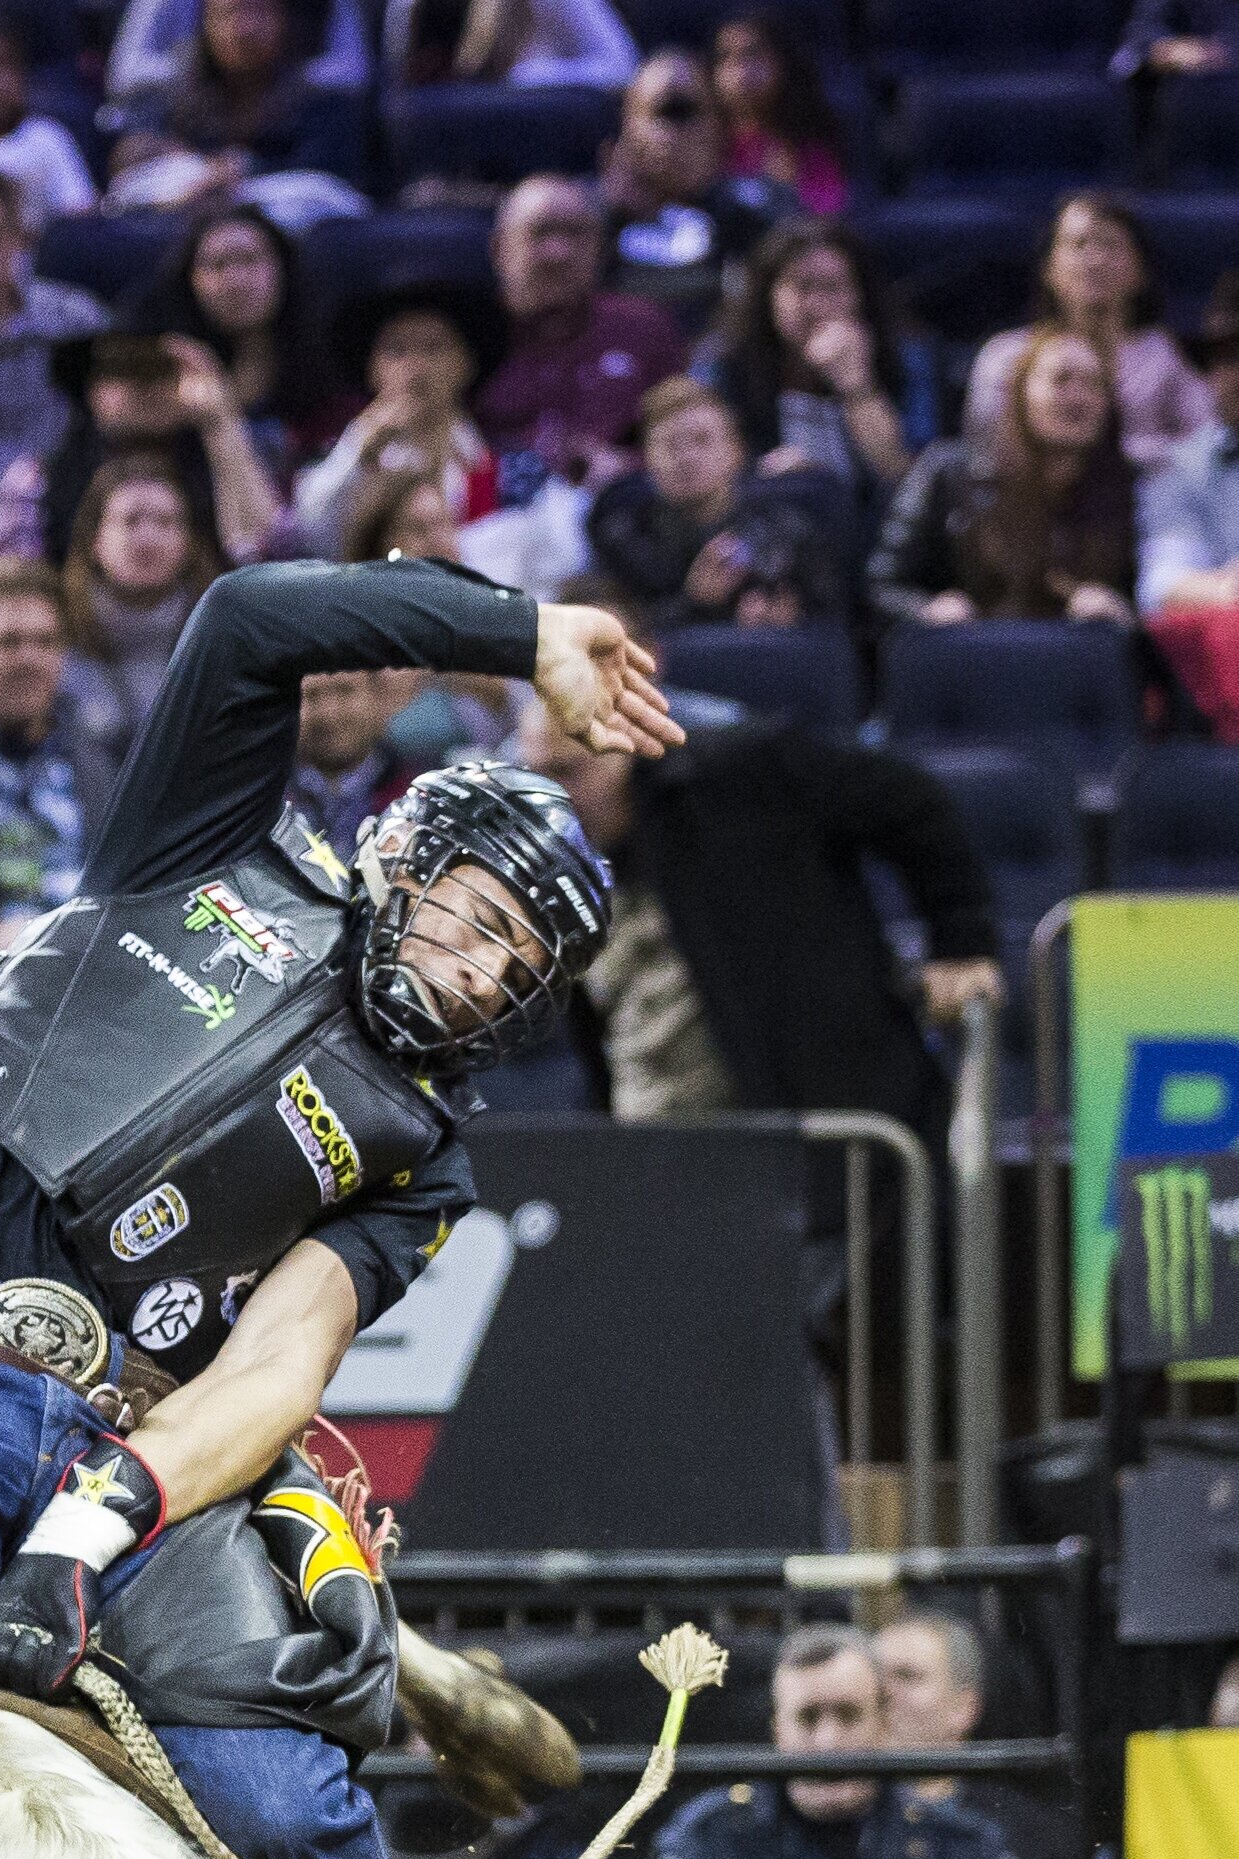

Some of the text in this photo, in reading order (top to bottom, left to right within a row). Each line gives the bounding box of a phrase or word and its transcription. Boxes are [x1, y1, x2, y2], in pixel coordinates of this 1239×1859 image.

[201, 883, 295, 958] PBR
[117, 931, 216, 1011] FIT-N-WISE
[284, 1071, 361, 1192] ROCKST
